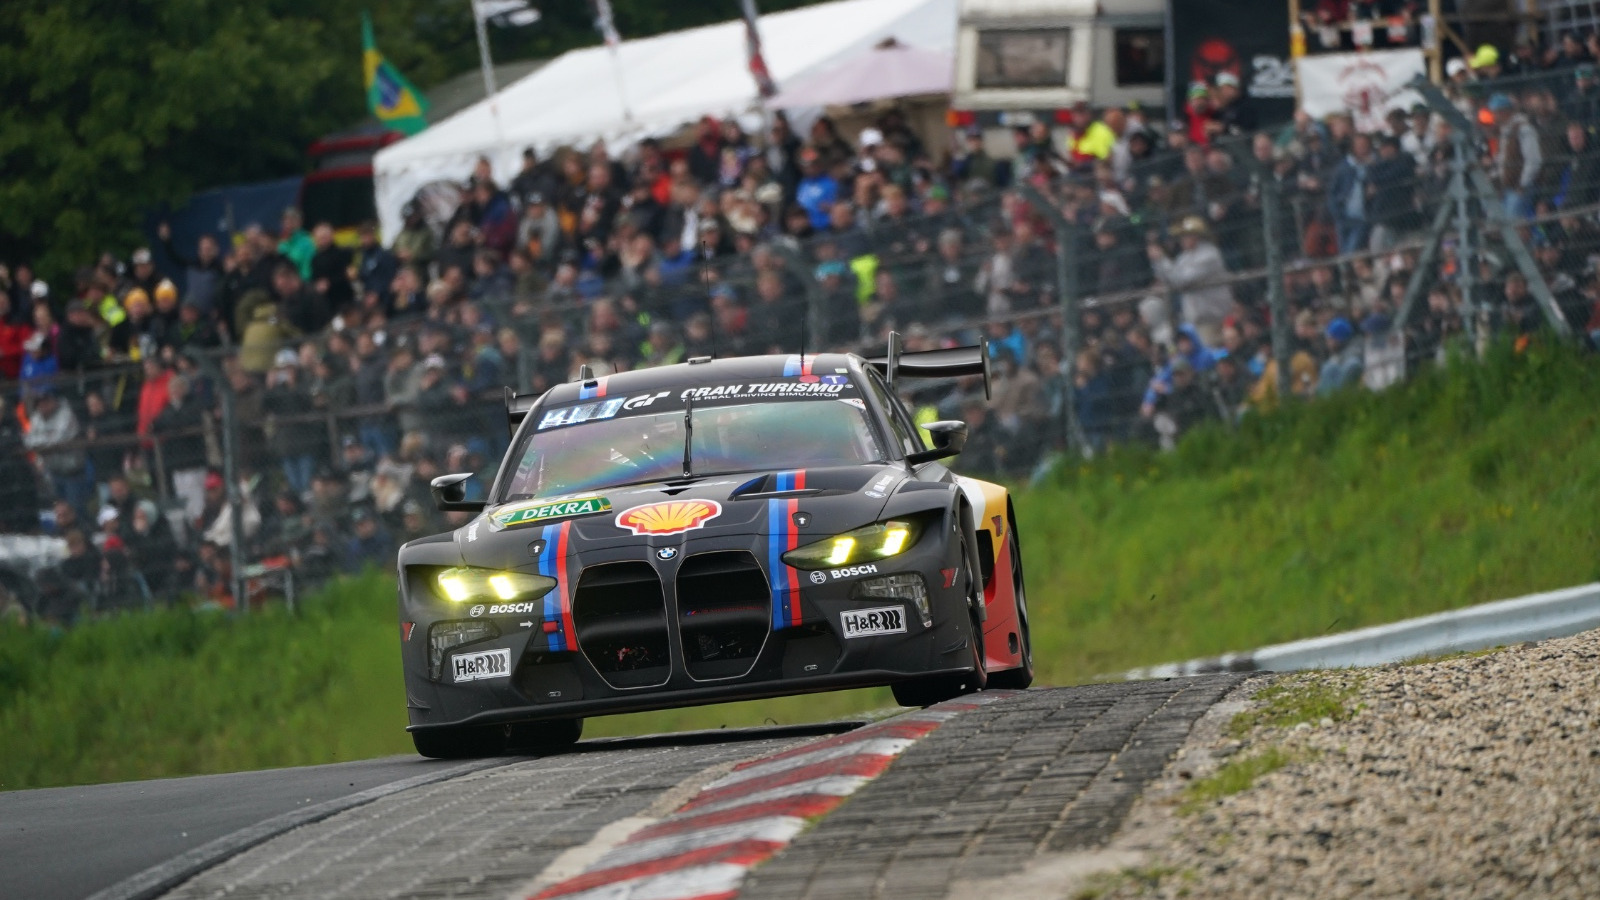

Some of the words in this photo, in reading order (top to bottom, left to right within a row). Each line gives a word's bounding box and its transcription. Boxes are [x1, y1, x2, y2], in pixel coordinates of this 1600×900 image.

[825, 375, 841, 384] T
[680, 384, 743, 399] GRAN
[747, 382, 844, 394] TURISMO
[522, 501, 593, 520] DEKRA
[831, 564, 878, 579] BOSCH
[489, 603, 534, 614] BOSCH
[845, 612, 880, 632] H&R
[455, 657, 486, 676] H&R
